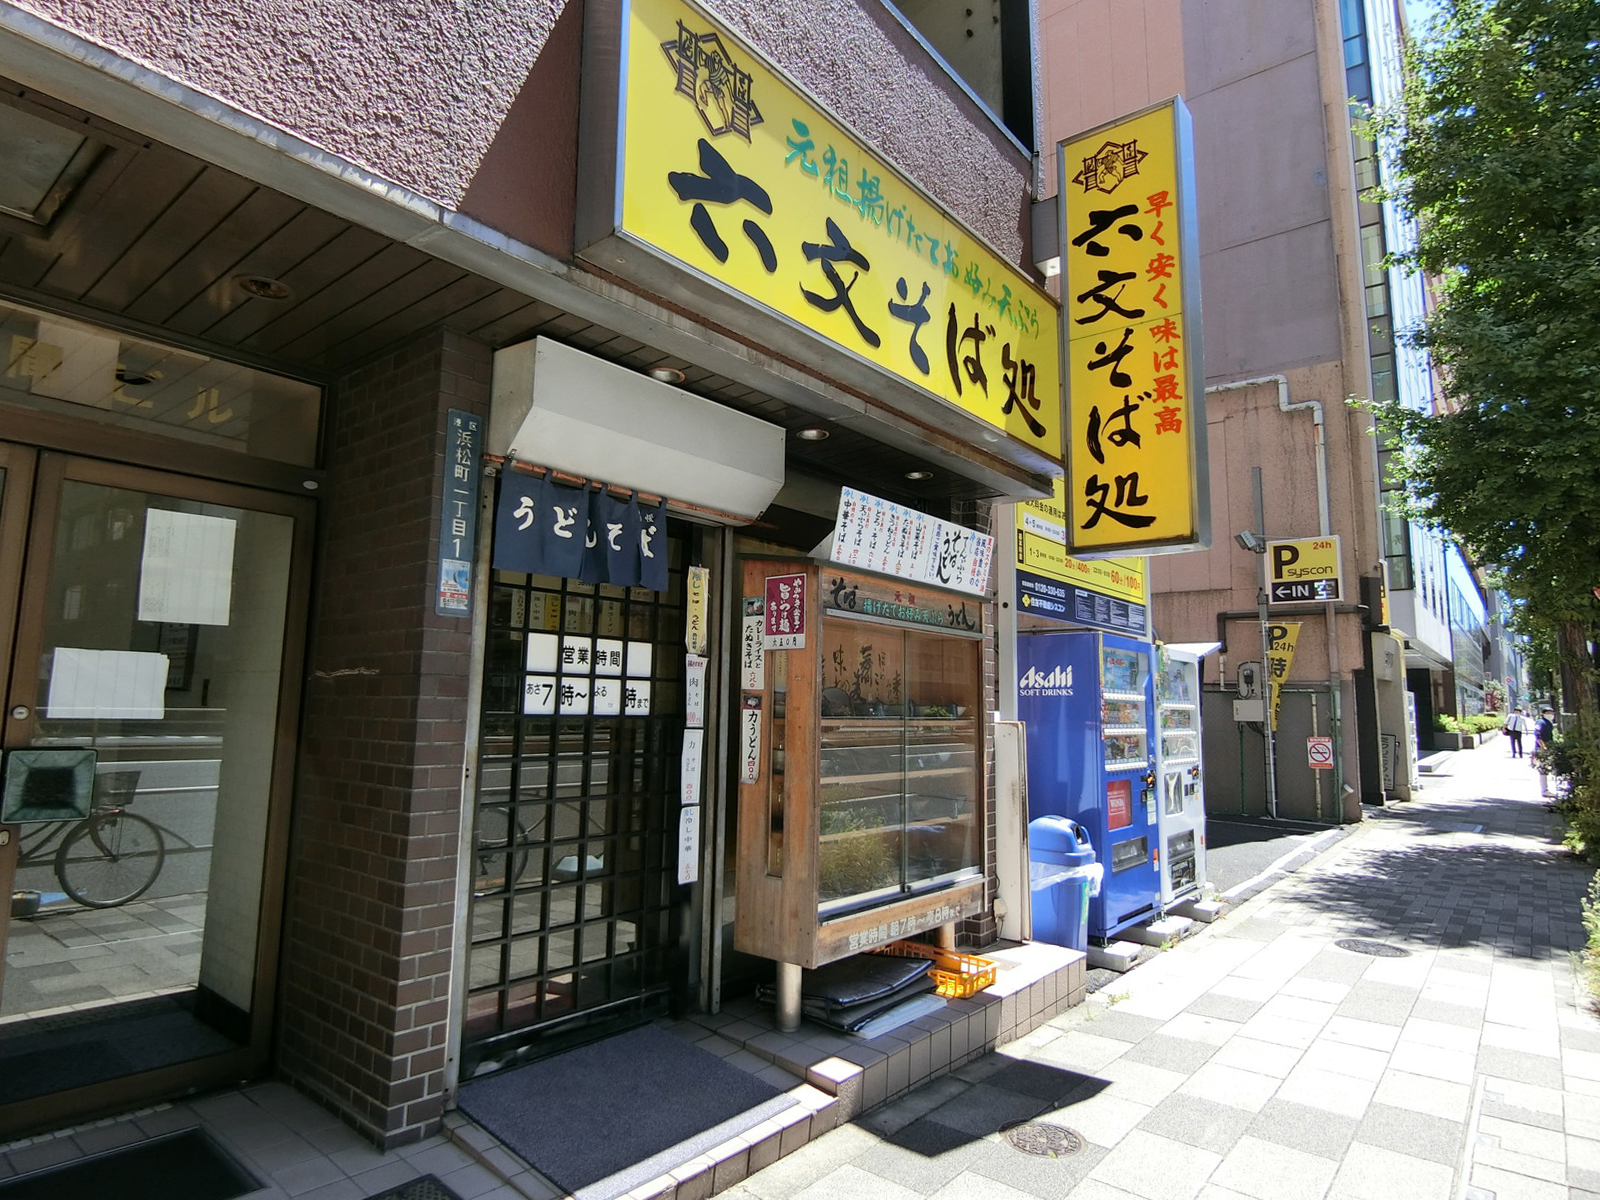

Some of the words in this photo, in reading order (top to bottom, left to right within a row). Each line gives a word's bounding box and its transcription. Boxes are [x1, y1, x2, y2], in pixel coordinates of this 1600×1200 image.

[1144, 190, 1175, 309] 早く安く
[668, 138, 1046, 438] 六文そば処
[1072, 204, 1156, 529] 六文そば処
[1149, 318, 1183, 435] 味は最高
[1313, 541, 1332, 549] 24h
[1273, 545, 1299, 579] P
[1287, 566, 1333, 578] syscon
[830, 577, 859, 609] そば
[1292, 585, 1309, 597] IN
[744, 624, 753, 669] たぬきそば
[754, 620, 763, 669] カレーライスと
[1269, 626, 1287, 650] P
[1274, 642, 1294, 652] 24h
[563, 645, 621, 667] 営業時間
[689, 677, 698, 687] 肉
[1019, 664, 1073, 689] Asahi
[1042, 688, 1074, 696] DRINKS
[849, 923, 888, 950] 営業時間
